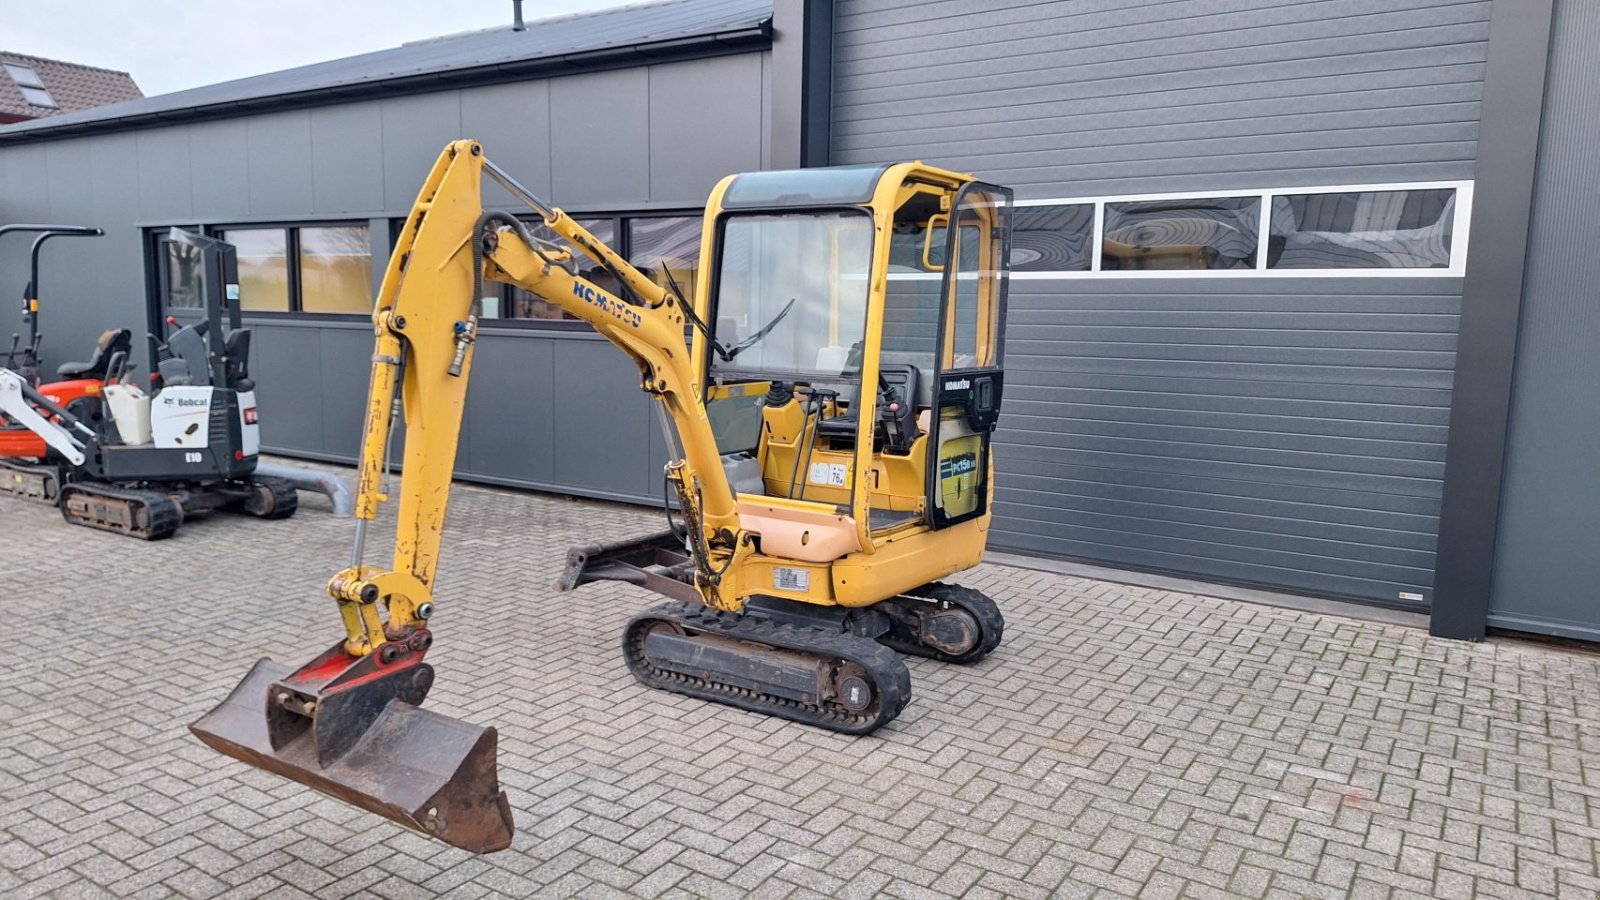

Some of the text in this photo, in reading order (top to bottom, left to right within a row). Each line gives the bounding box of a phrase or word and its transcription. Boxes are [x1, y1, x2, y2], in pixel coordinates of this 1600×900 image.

[945, 378, 970, 391] KOMATSU
[178, 398, 207, 407] Bobcat
[185, 452, 203, 463] E10
